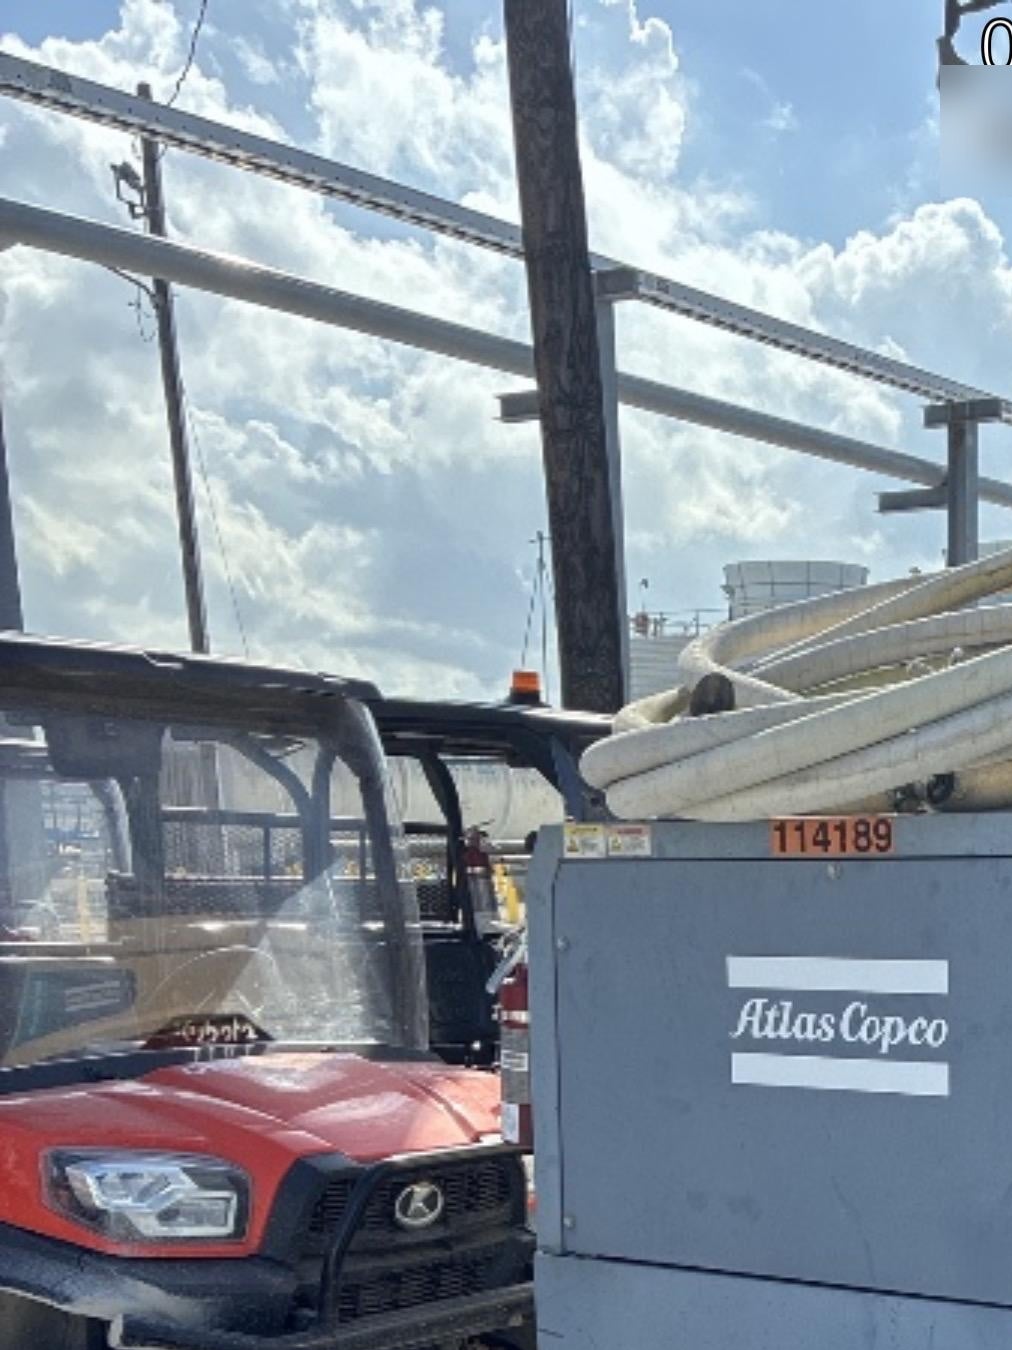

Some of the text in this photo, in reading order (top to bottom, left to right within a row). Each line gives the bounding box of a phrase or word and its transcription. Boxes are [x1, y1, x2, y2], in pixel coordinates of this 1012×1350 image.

[772, 818, 893, 854] 114189
[729, 998, 949, 1053] Atlas Copco
